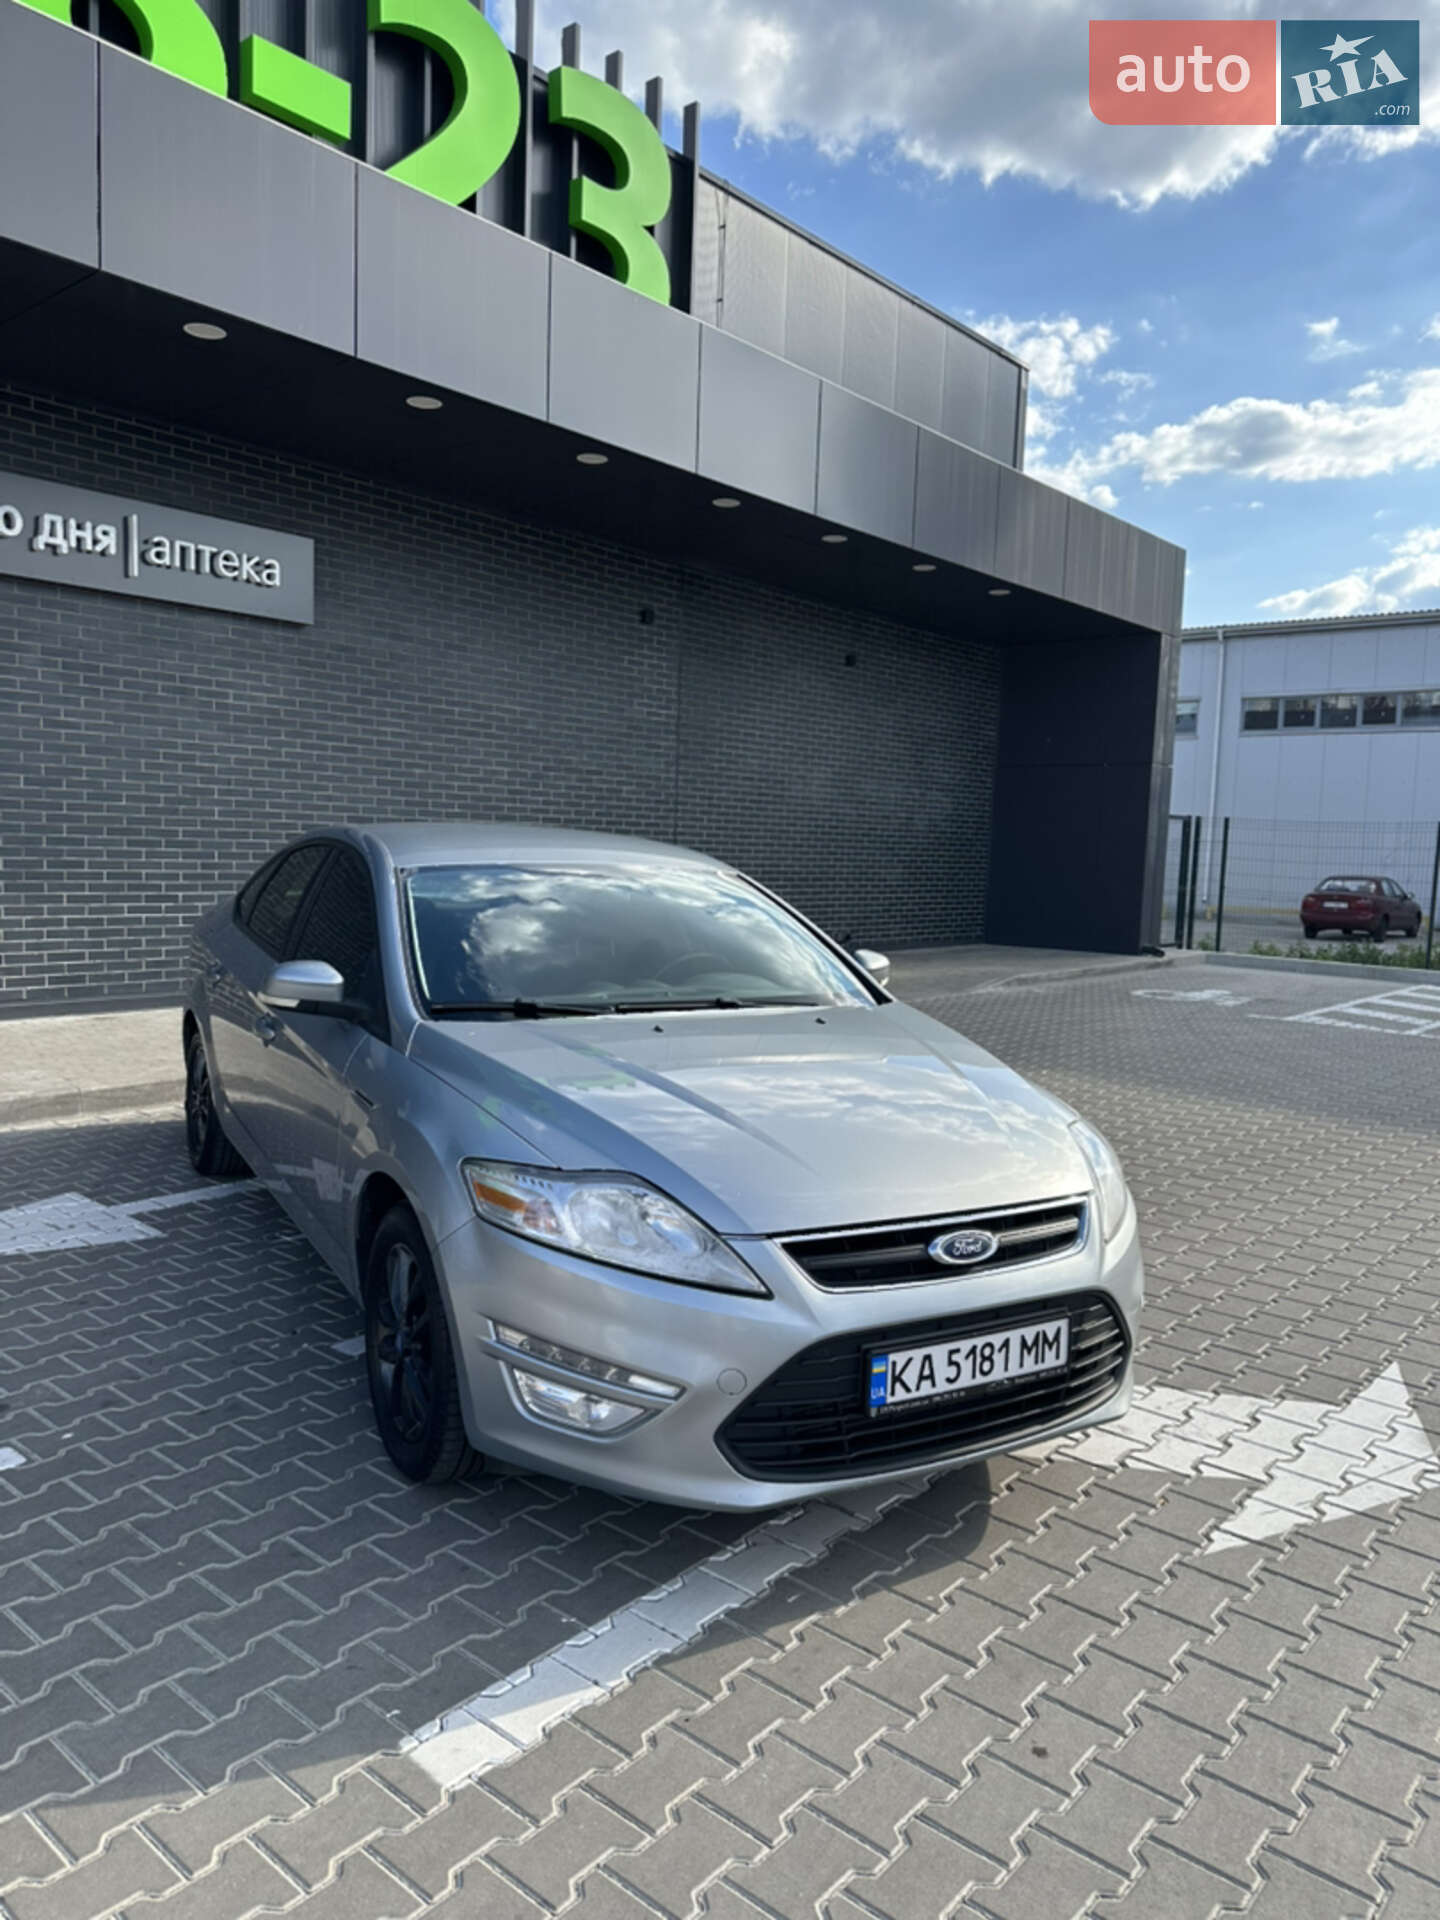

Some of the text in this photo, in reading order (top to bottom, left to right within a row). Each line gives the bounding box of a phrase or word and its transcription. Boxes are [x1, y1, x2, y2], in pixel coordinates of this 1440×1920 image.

[32, 512, 117, 555] дня
[149, 535, 281, 587] аптека
[952, 1237, 983, 1256] Ford
[889, 1325, 1062, 1398] KA 5181 MM
[871, 1386, 885, 1400] UA
